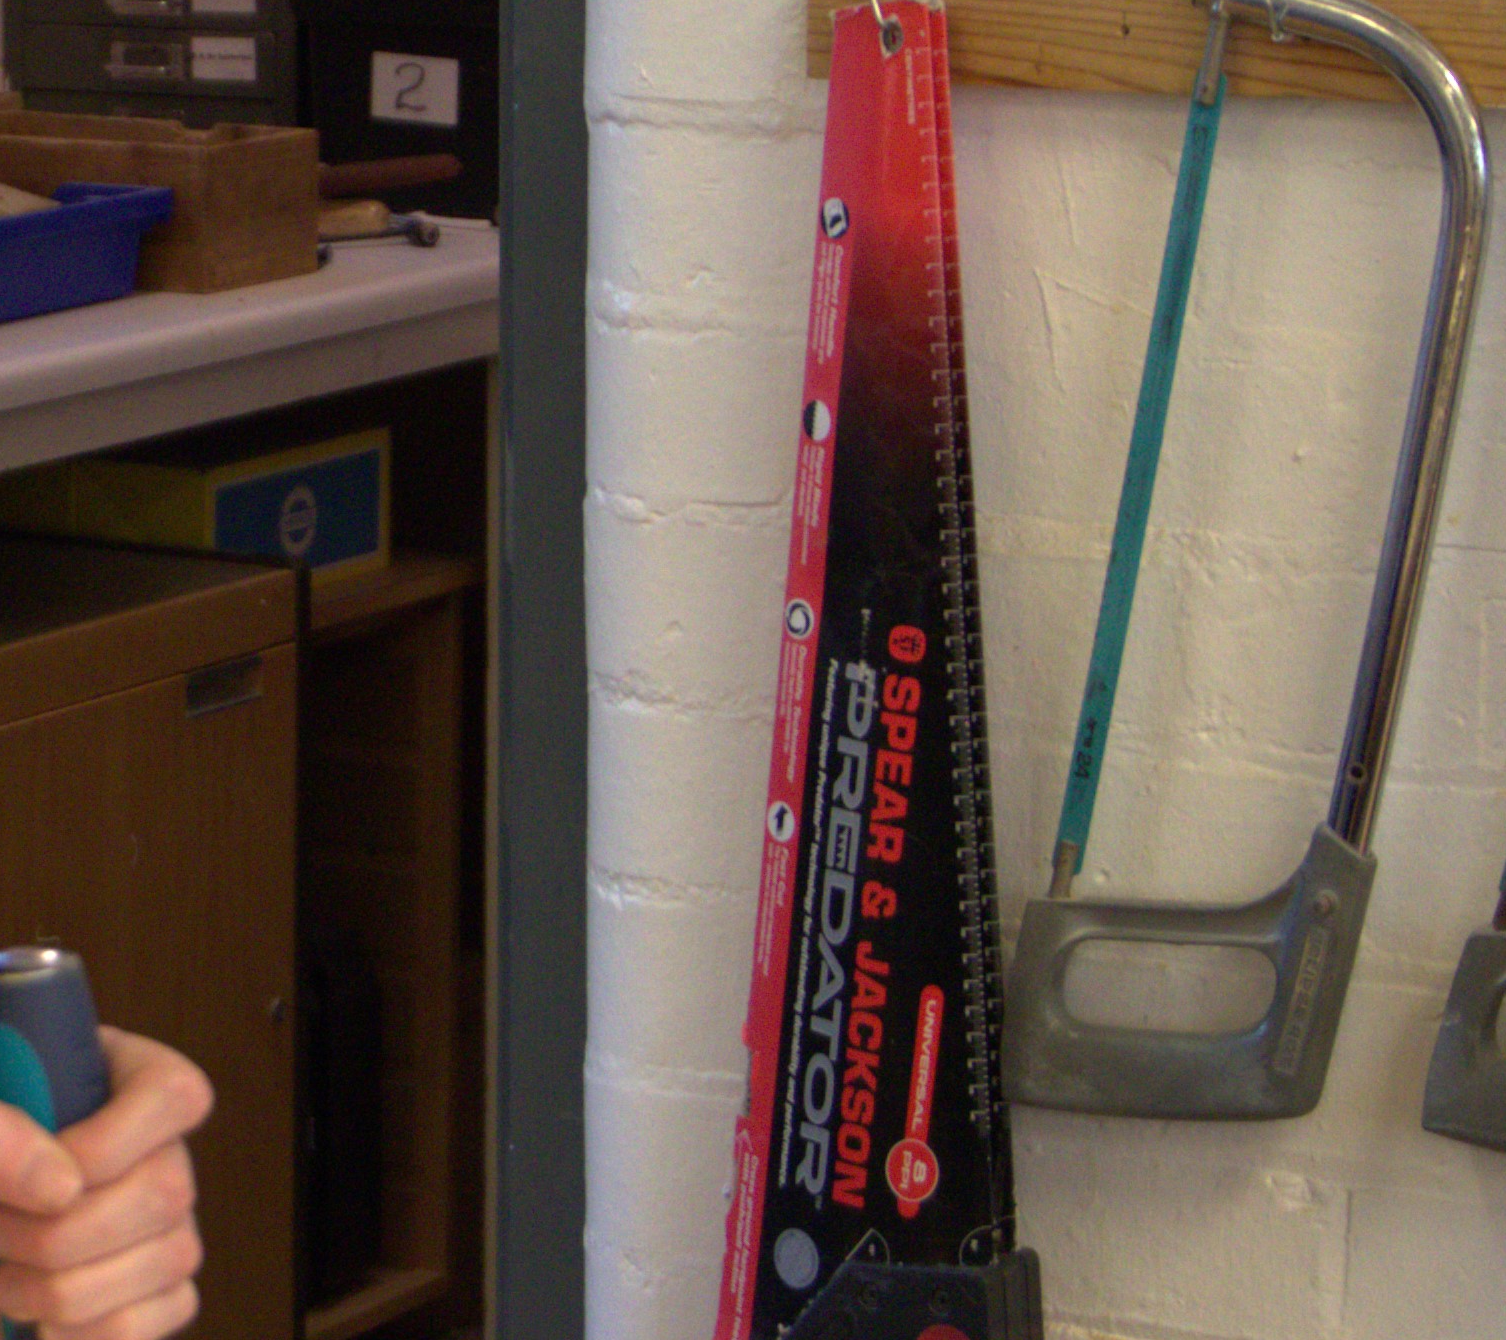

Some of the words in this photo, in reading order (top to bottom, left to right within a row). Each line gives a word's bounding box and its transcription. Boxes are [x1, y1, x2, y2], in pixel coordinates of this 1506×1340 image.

[394, 62, 428, 113] 2
[822, 658, 838, 721] Featuring
[817, 722, 831, 768] unique
[867, 673, 921, 865] SPEAR
[803, 842, 820, 913] technology
[861, 879, 897, 920] &
[796, 661, 876, 1195] PREDATOR
[802, 914, 813, 935] for
[794, 934, 811, 1012] outstanding
[787, 1012, 803, 1074] durability
[911, 999, 937, 1132] UNIVERSAL
[784, 1075, 796, 1101] and
[832, 941, 890, 1210] JACKSON
[913, 1161, 927, 1184] 8
